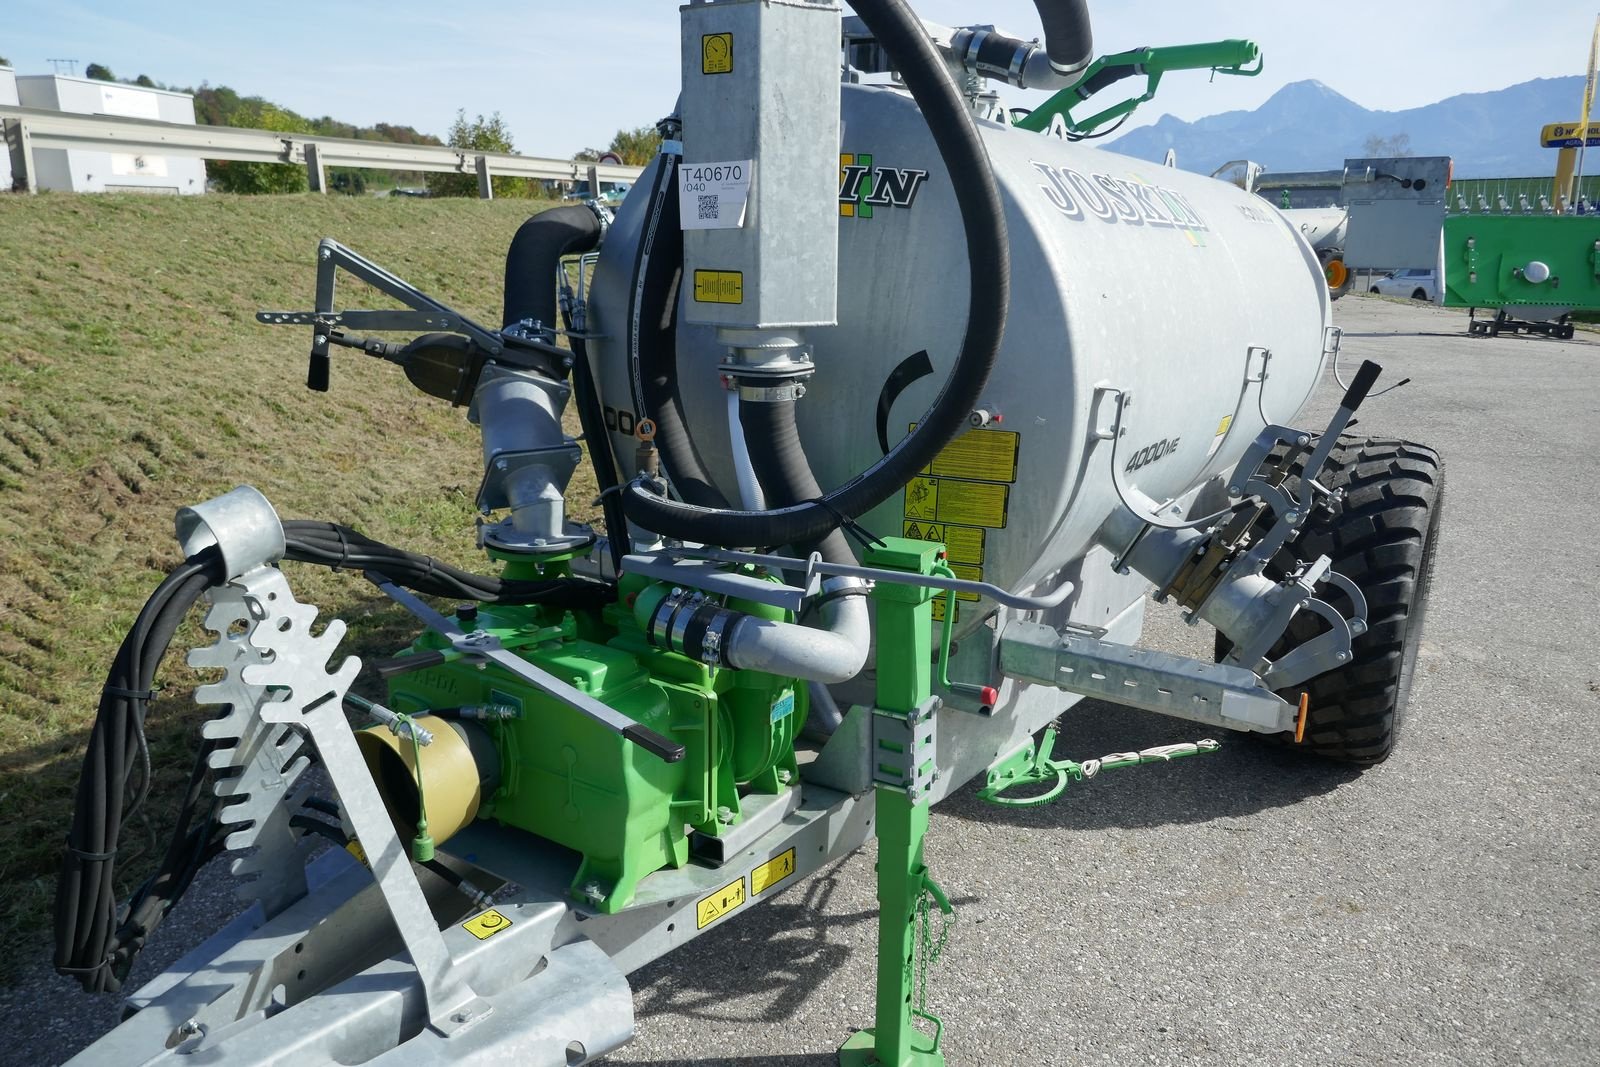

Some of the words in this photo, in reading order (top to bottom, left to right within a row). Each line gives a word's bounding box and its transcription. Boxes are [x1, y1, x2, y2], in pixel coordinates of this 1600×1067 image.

[682, 166, 741, 181] T40670
[683, 183, 705, 192] /040
[1028, 159, 1209, 232] JOSKIN
